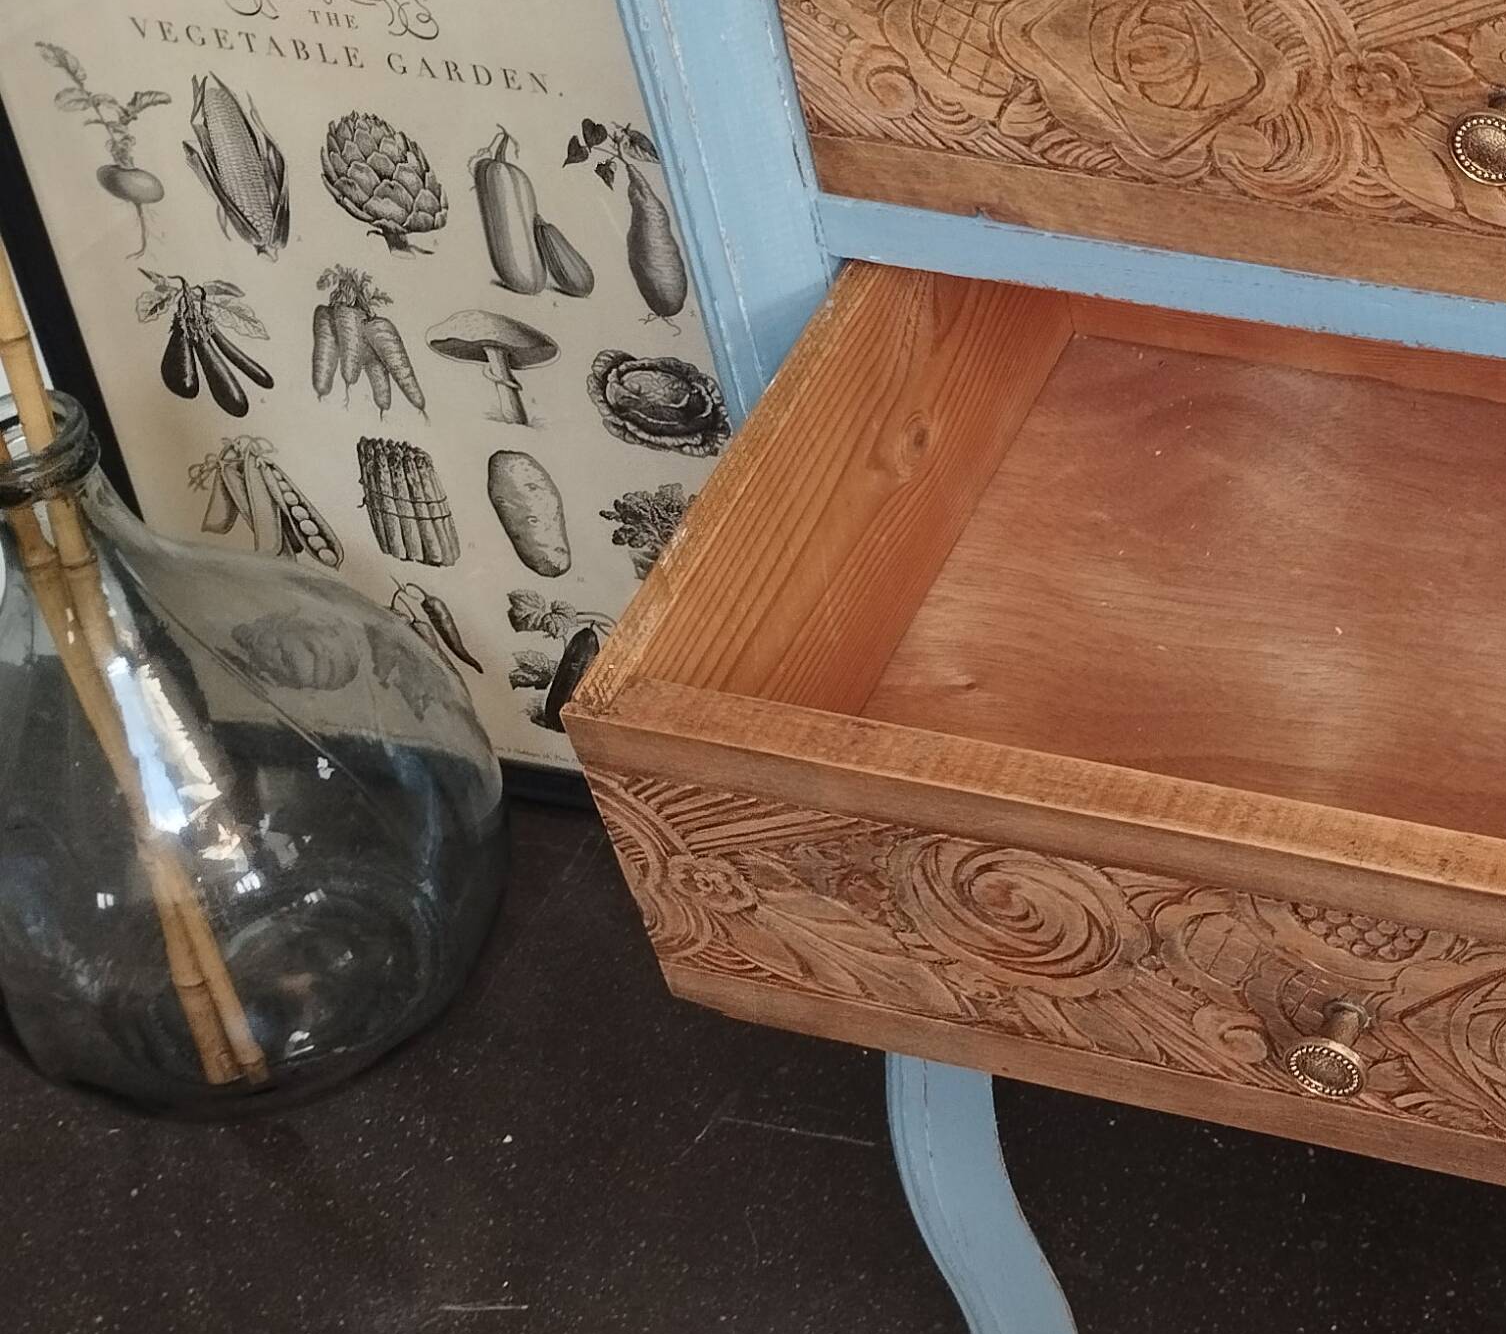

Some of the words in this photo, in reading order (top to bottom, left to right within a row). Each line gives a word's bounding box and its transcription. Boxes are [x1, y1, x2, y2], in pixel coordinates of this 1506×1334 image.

[308, 9, 359, 30] THE
[128, 16, 365, 69] VEGETABLE
[386, 52, 564, 98] GARDEN.
